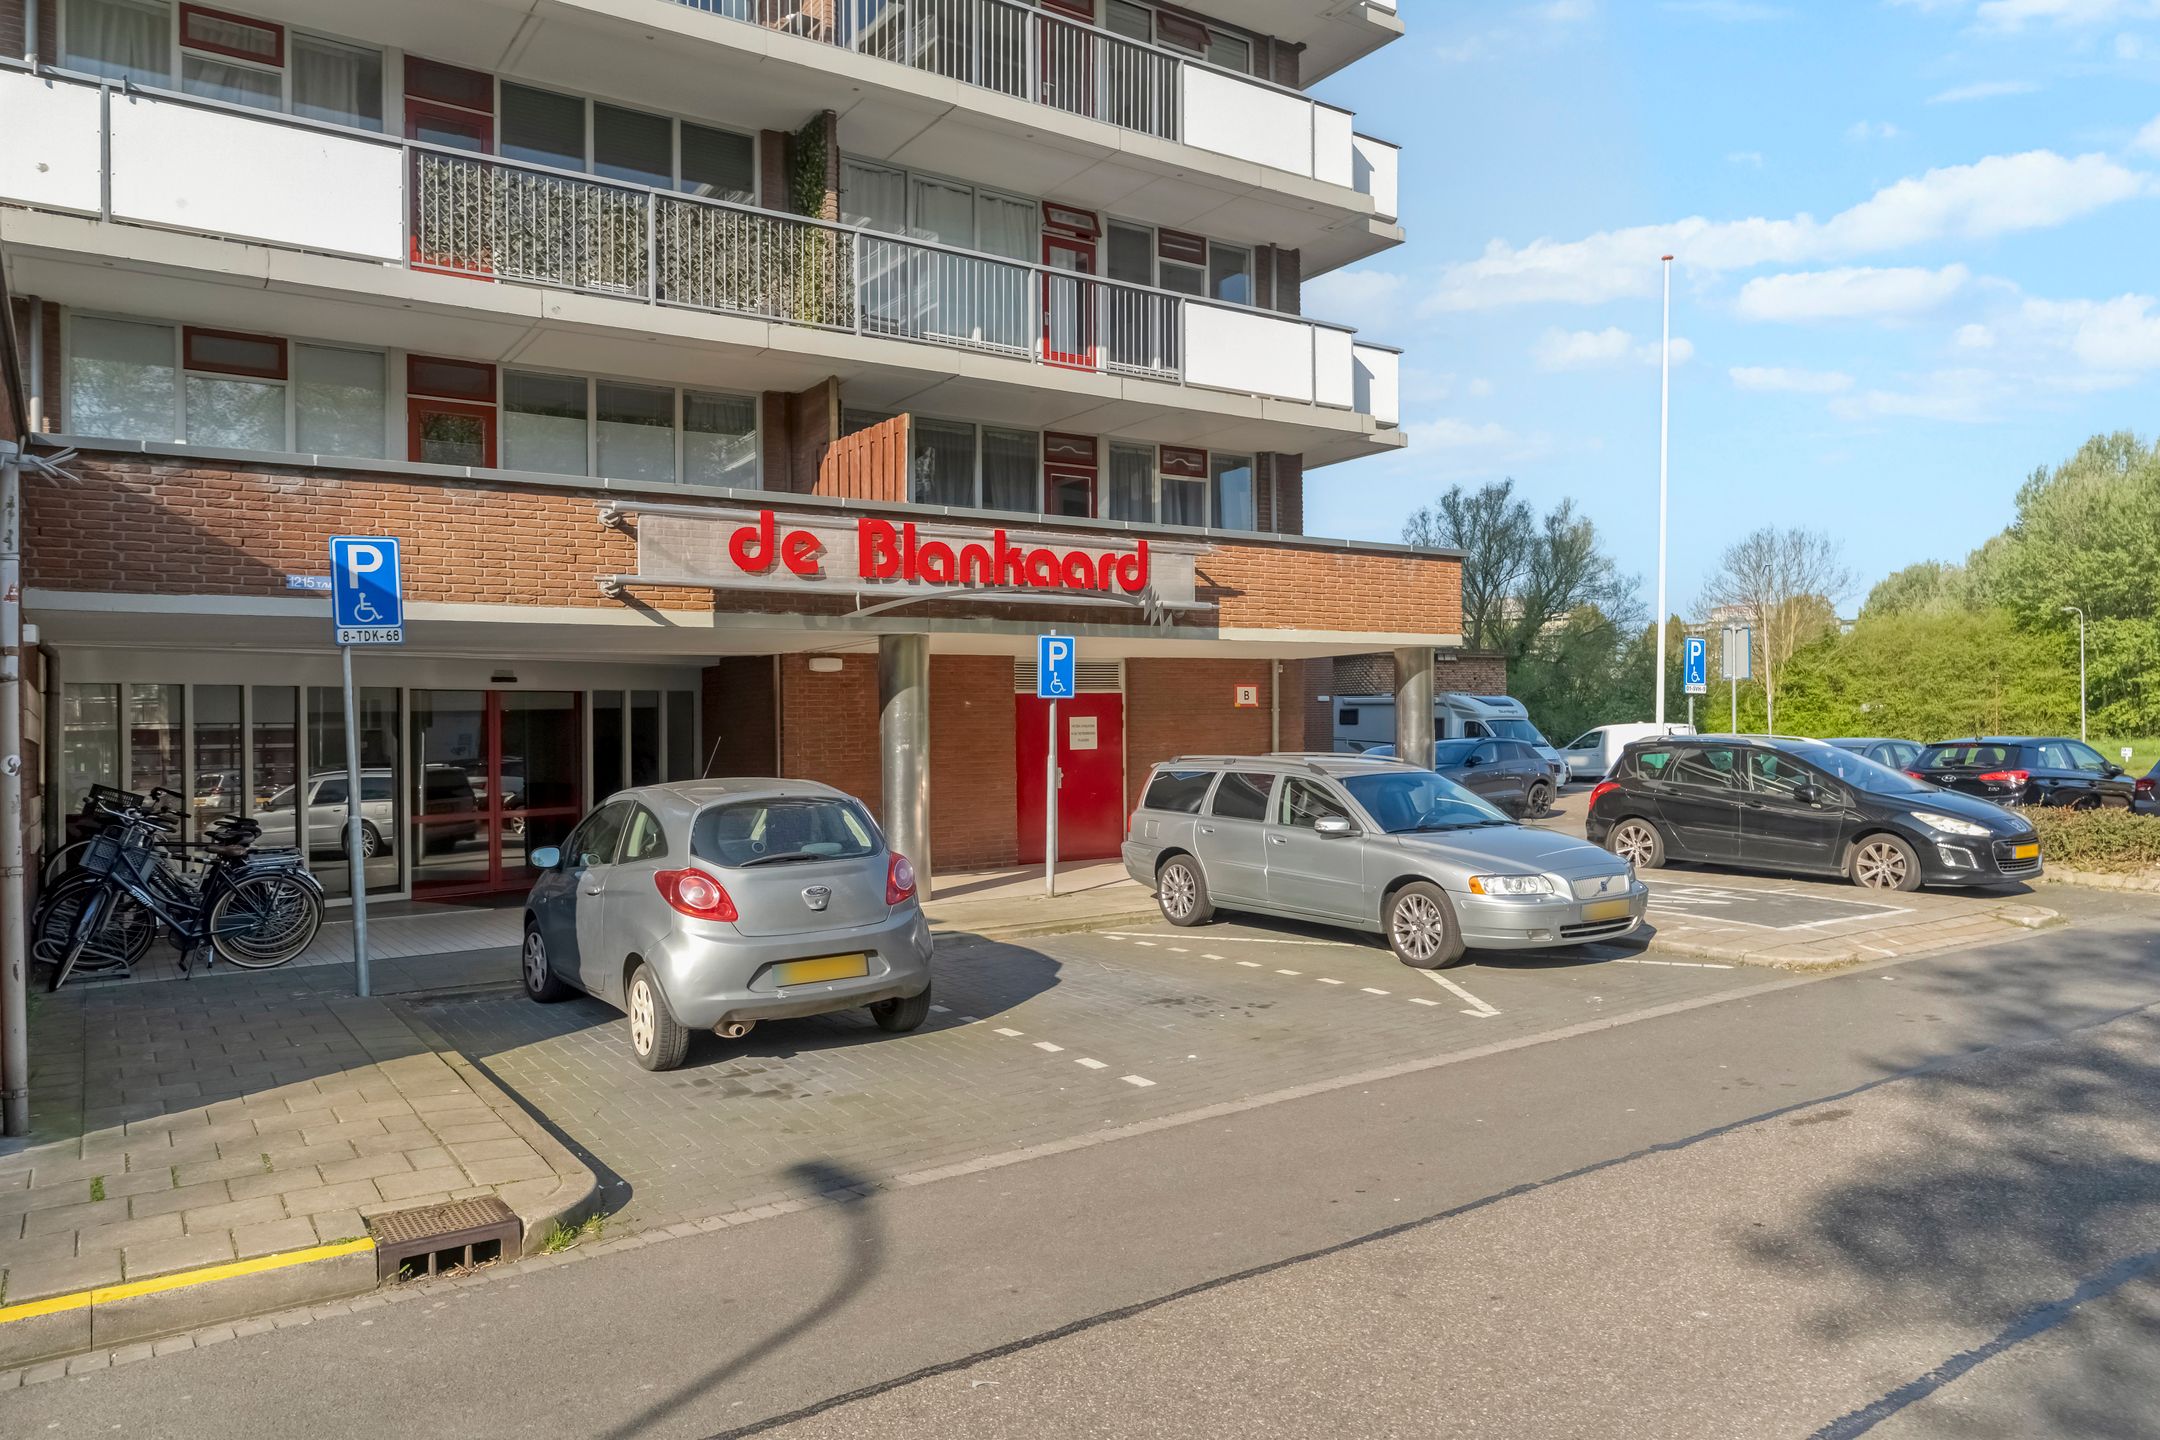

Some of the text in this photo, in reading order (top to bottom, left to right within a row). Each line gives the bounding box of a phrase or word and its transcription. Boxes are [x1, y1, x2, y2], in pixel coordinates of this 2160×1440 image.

[728, 509, 1148, 592] de Blankaard
[347, 544, 384, 589] P
[288, 576, 315, 588] 1215
[342, 630, 400, 642] 8-TDK-68
[1049, 641, 1068, 672] P
[1690, 641, 1702, 665] P
[1243, 690, 1250, 701] B
